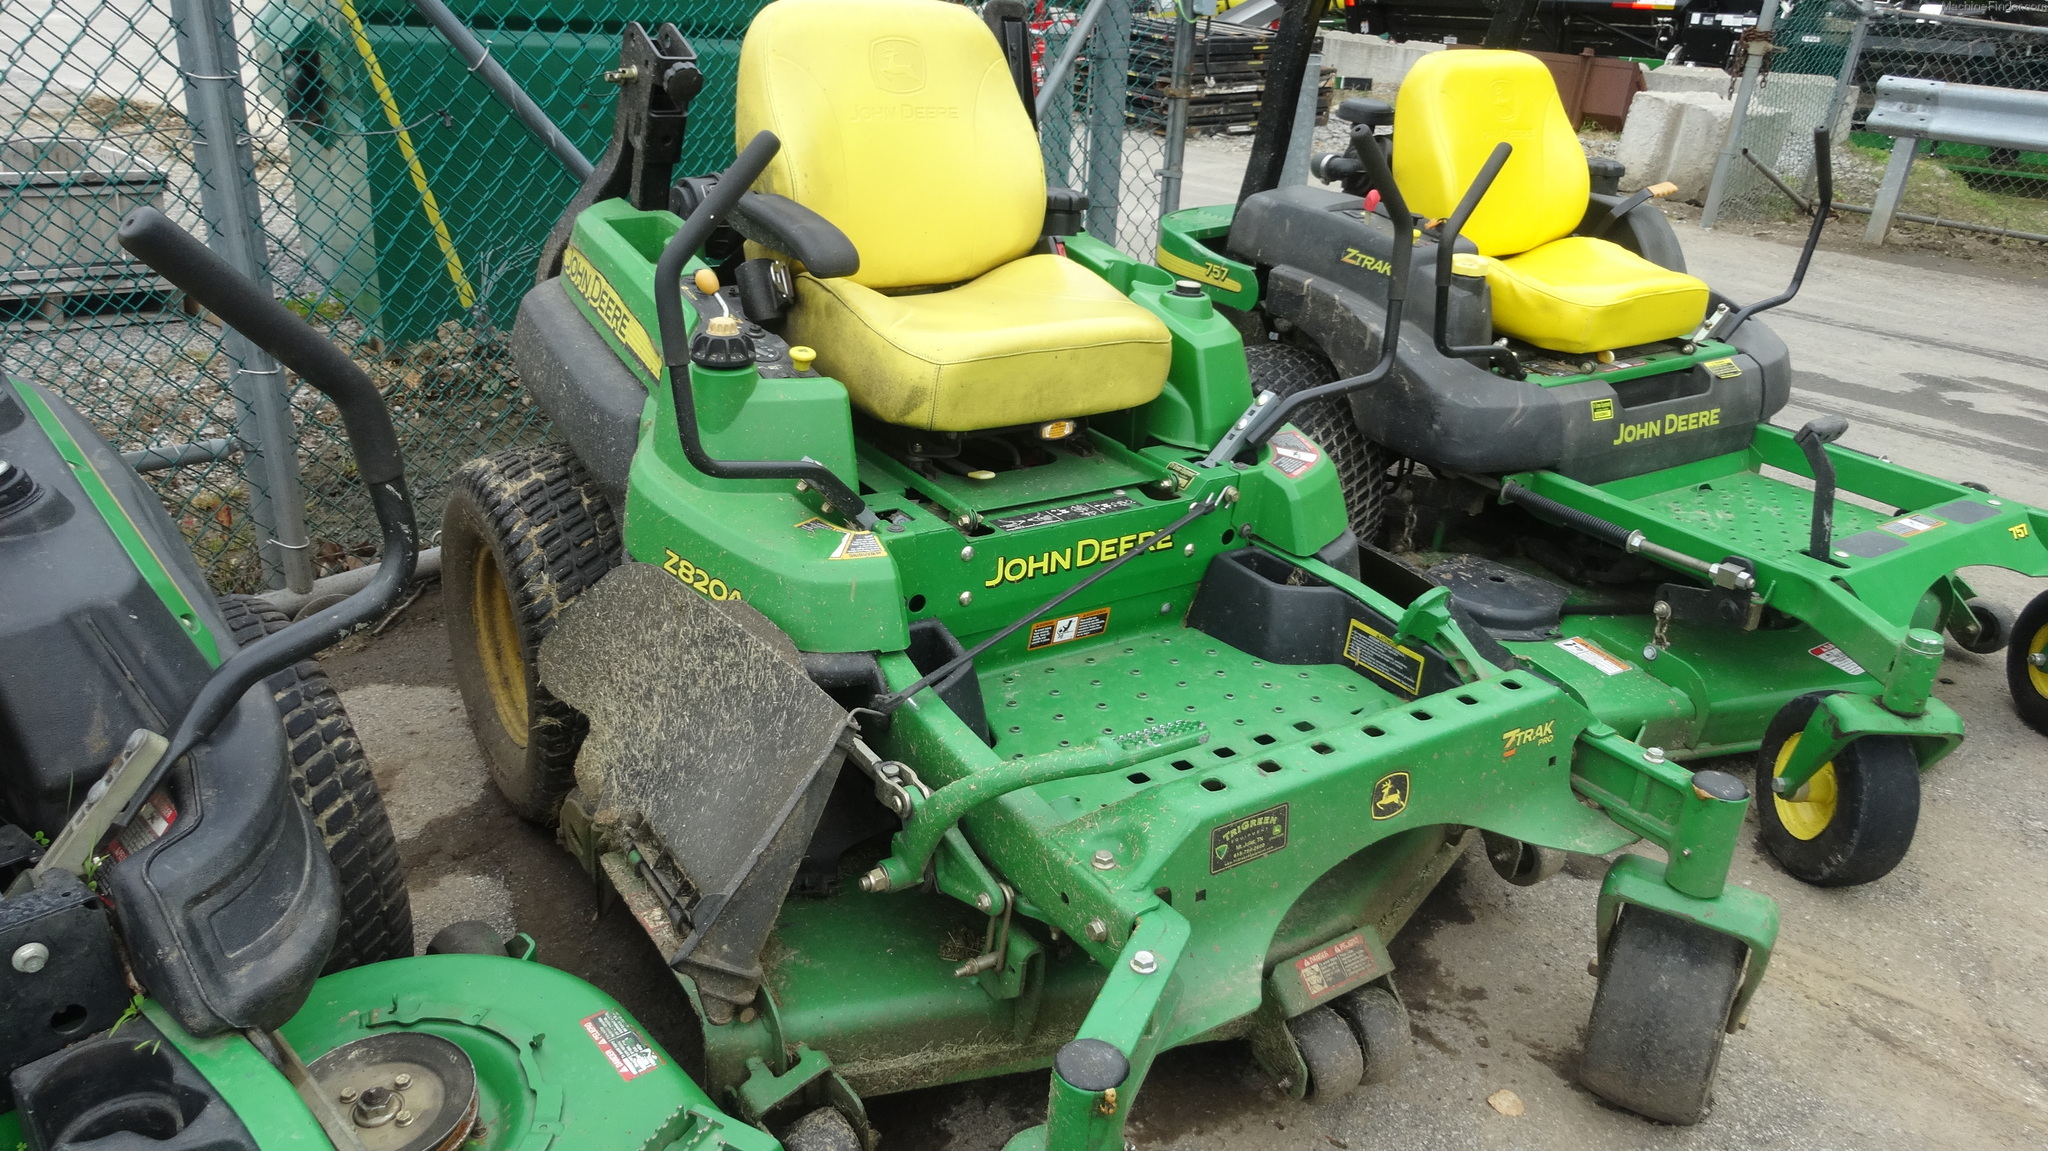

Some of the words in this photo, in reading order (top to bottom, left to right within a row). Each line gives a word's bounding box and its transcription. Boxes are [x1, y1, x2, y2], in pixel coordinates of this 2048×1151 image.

[901, 104, 960, 120] DEERE
[1205, 261, 1230, 281] 757
[588, 274, 631, 345] DEERE
[1613, 419, 1661, 446] JOHN
[1664, 408, 1721, 435] DEERE
[2007, 523, 2030, 541] 757
[984, 547, 1073, 589] JOHN
[1537, 734, 1554, 747] PRO
[1222, 816, 1278, 841] TRIGREEN
